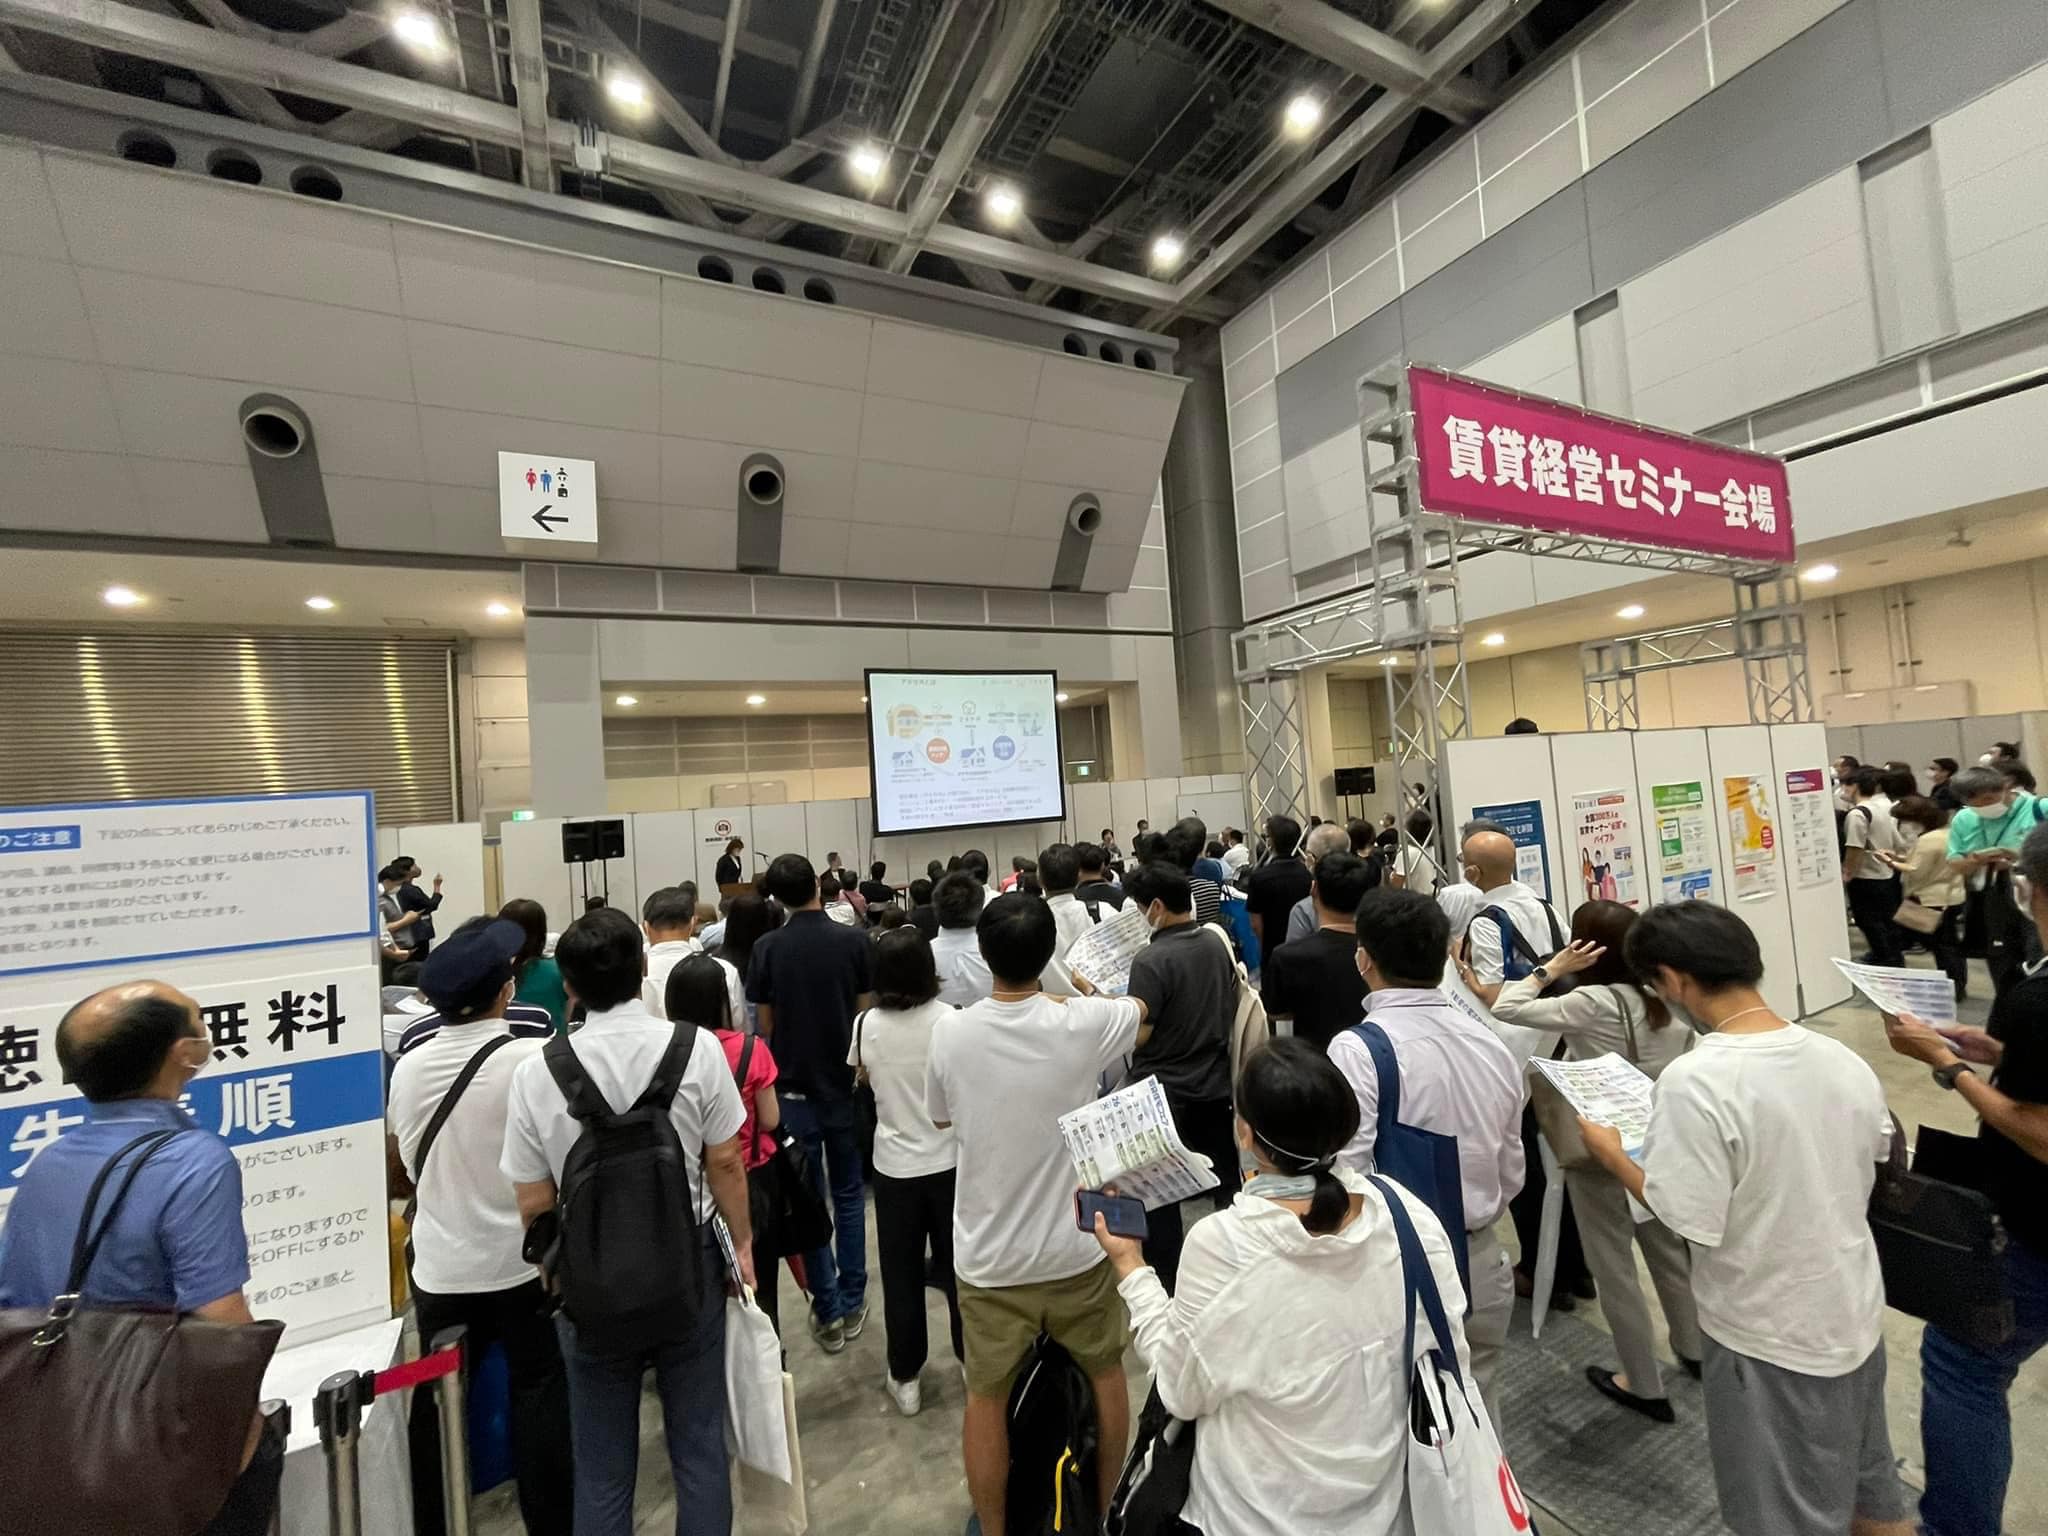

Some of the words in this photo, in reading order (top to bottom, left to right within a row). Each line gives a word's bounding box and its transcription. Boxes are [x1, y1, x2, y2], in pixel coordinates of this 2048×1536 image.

[1442, 414, 1776, 534] 賃貸経営セミナー会場
[0, 872, 232, 897] 配布する資料には限りがございます。
[237, 1137, 353, 1170] がございます。
